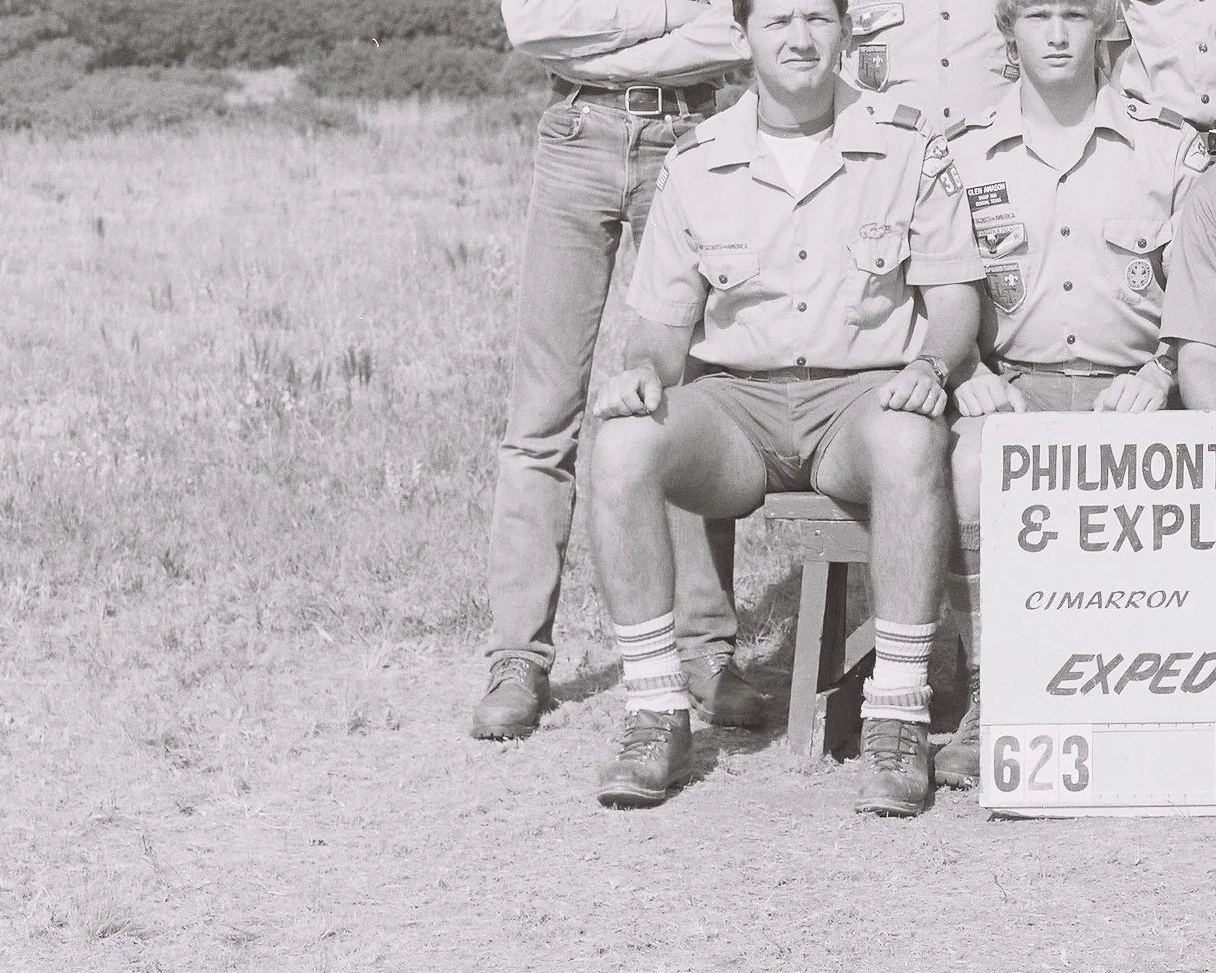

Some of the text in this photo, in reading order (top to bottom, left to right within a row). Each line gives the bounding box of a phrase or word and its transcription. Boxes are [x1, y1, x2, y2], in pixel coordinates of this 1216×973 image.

[1018, 505, 1058, 552] &
[1025, 591, 1189, 610] CIMARRON
[994, 735, 1089, 792] 623
